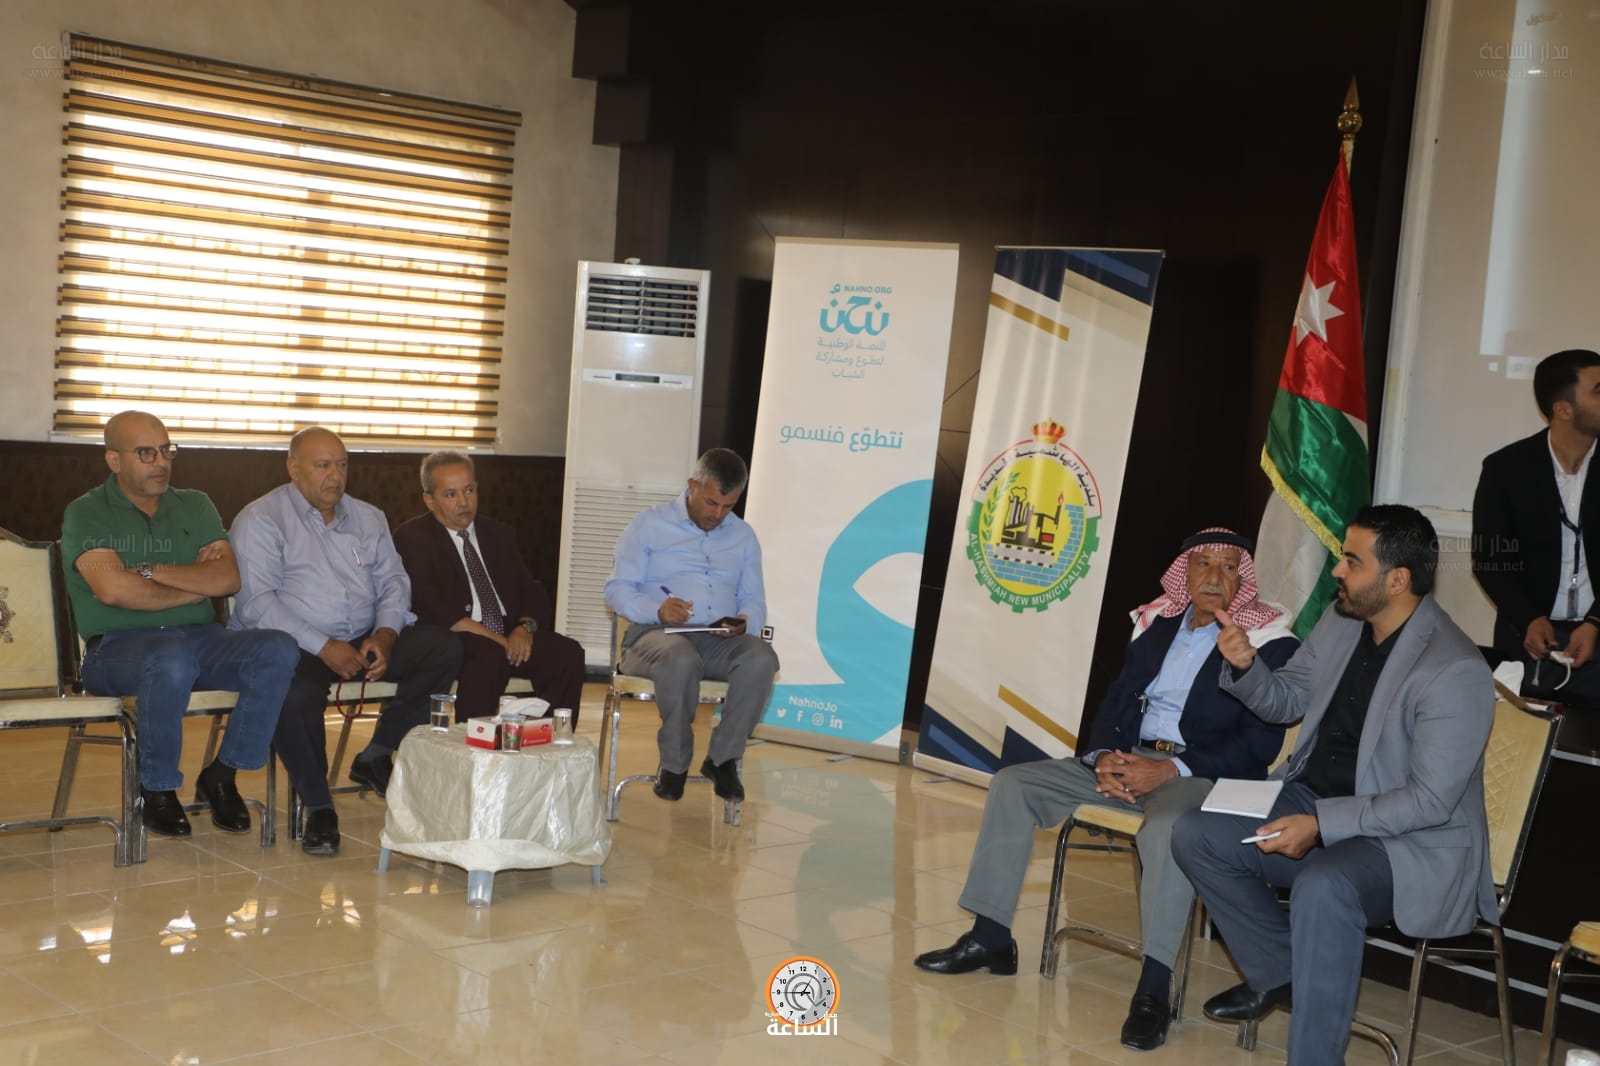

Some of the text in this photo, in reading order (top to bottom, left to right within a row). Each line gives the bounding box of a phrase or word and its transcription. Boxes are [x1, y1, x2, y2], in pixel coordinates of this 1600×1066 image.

[844, 285, 892, 294] NAHNO.ORG
[779, 424, 845, 445] فنسمو
[1077, 472, 1096, 507] بلدية
[970, 533, 1089, 606] AL-HASHMIAH NEW MUNICIPALITY
